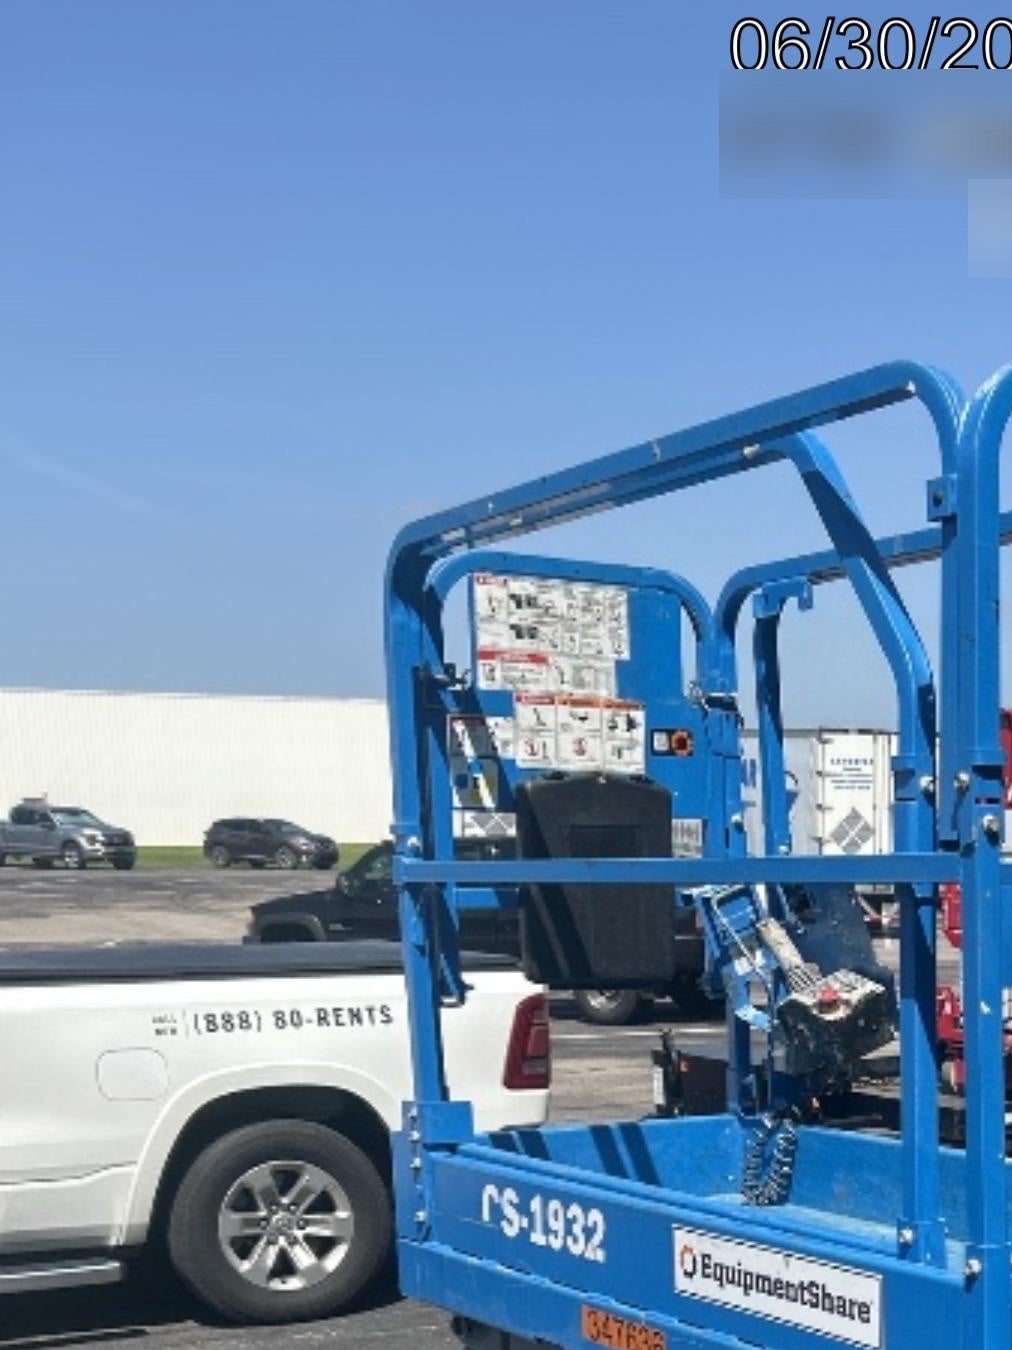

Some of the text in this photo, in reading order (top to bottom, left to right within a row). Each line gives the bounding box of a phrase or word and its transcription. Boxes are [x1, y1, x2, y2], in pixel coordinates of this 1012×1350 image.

[194, 1005, 394, 1035] (888) 80-RENTS
[701, 1253, 871, 1324] EquipmentShare
